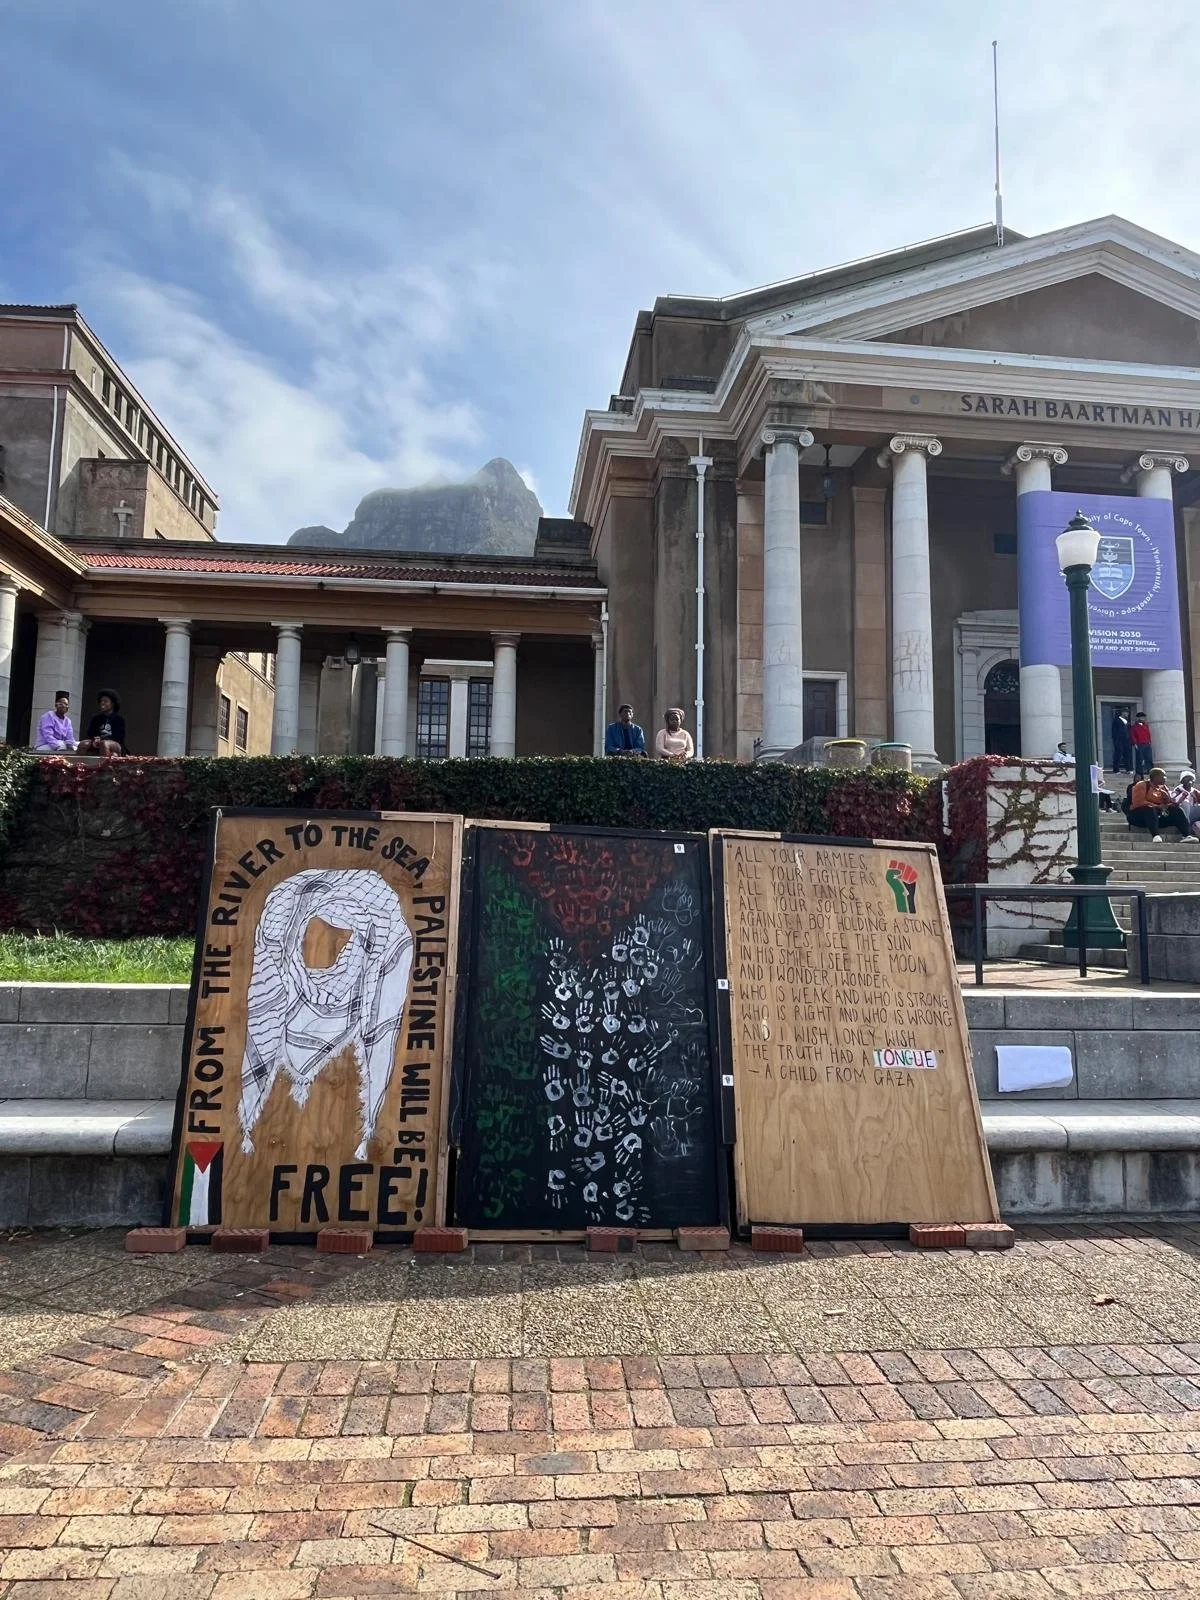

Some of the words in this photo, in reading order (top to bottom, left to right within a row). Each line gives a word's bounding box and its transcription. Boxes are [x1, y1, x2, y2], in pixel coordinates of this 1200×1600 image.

[960, 394, 1036, 416] SARAH
[1045, 401, 1172, 426] BAARTMAN
[1114, 514, 1132, 526] Cape
[1136, 524, 1151, 542] Town
[1120, 630, 1141, 638] 2030
[285, 824, 322, 850] TO
[332, 825, 380, 851] THE
[380, 836, 430, 889] SEA,
[770, 848, 806, 864] YOUR
[212, 838, 285, 926] RIVER
[738, 862, 760, 879] ALL
[769, 864, 803, 882] YOUR
[739, 880, 762, 895] ALL
[770, 882, 806, 897] YOUR
[740, 896, 762, 911] ALL
[773, 897, 807, 912] YOUR
[740, 912, 789, 928] AGAINST
[796, 913, 802, 930] A
[808, 914, 832, 930] BOY
[838, 916, 887, 932] HOLDING
[894, 920, 901, 932] A
[904, 918, 941, 936] STONE
[825, 932, 848, 950] SEE
[855, 934, 880, 951] THE
[887, 934, 912, 951] SUN
[202, 944, 232, 999] THE
[740, 945, 751, 961] IN
[757, 946, 774, 964] HIS
[828, 953, 850, 972] SEE
[856, 954, 880, 973] THE
[889, 954, 927, 974] MOON
[407, 896, 446, 1051] PALESTINE
[740, 964, 763, 981] AND
[740, 984, 766, 1000] WHO
[775, 986, 786, 1002] IS
[792, 986, 830, 1004] WEAK
[836, 989, 859, 1004] AND
[864, 990, 890, 1006] WHO
[896, 992, 904, 1008] IS
[907, 992, 948, 1008] STRONG
[742, 1004, 769, 1020] WHO
[777, 1005, 786, 1020] IS
[794, 1006, 832, 1022] RIGHT
[840, 1008, 858, 1022] AND
[862, 1008, 888, 1024] WHO
[894, 1010, 904, 1026] IS
[907, 1010, 952, 1026] WRONG
[742, 1024, 770, 1040] AND
[843, 1028, 876, 1046] ONLY
[884, 1029, 916, 1047] WISH
[744, 1044, 768, 1060] THE
[778, 1045, 822, 1060] TRUTH
[830, 1048, 854, 1064] HAD
[862, 1050, 870, 1066] A
[188, 1026, 226, 1134] FROM
[780, 1066, 817, 1082] CHILD
[826, 1066, 866, 1083] FROM
[874, 1069, 914, 1088] GAZA
[400, 1062, 430, 1122] WILL
[394, 1130, 426, 1165] BE
[270, 1163, 428, 1225] FREE!
